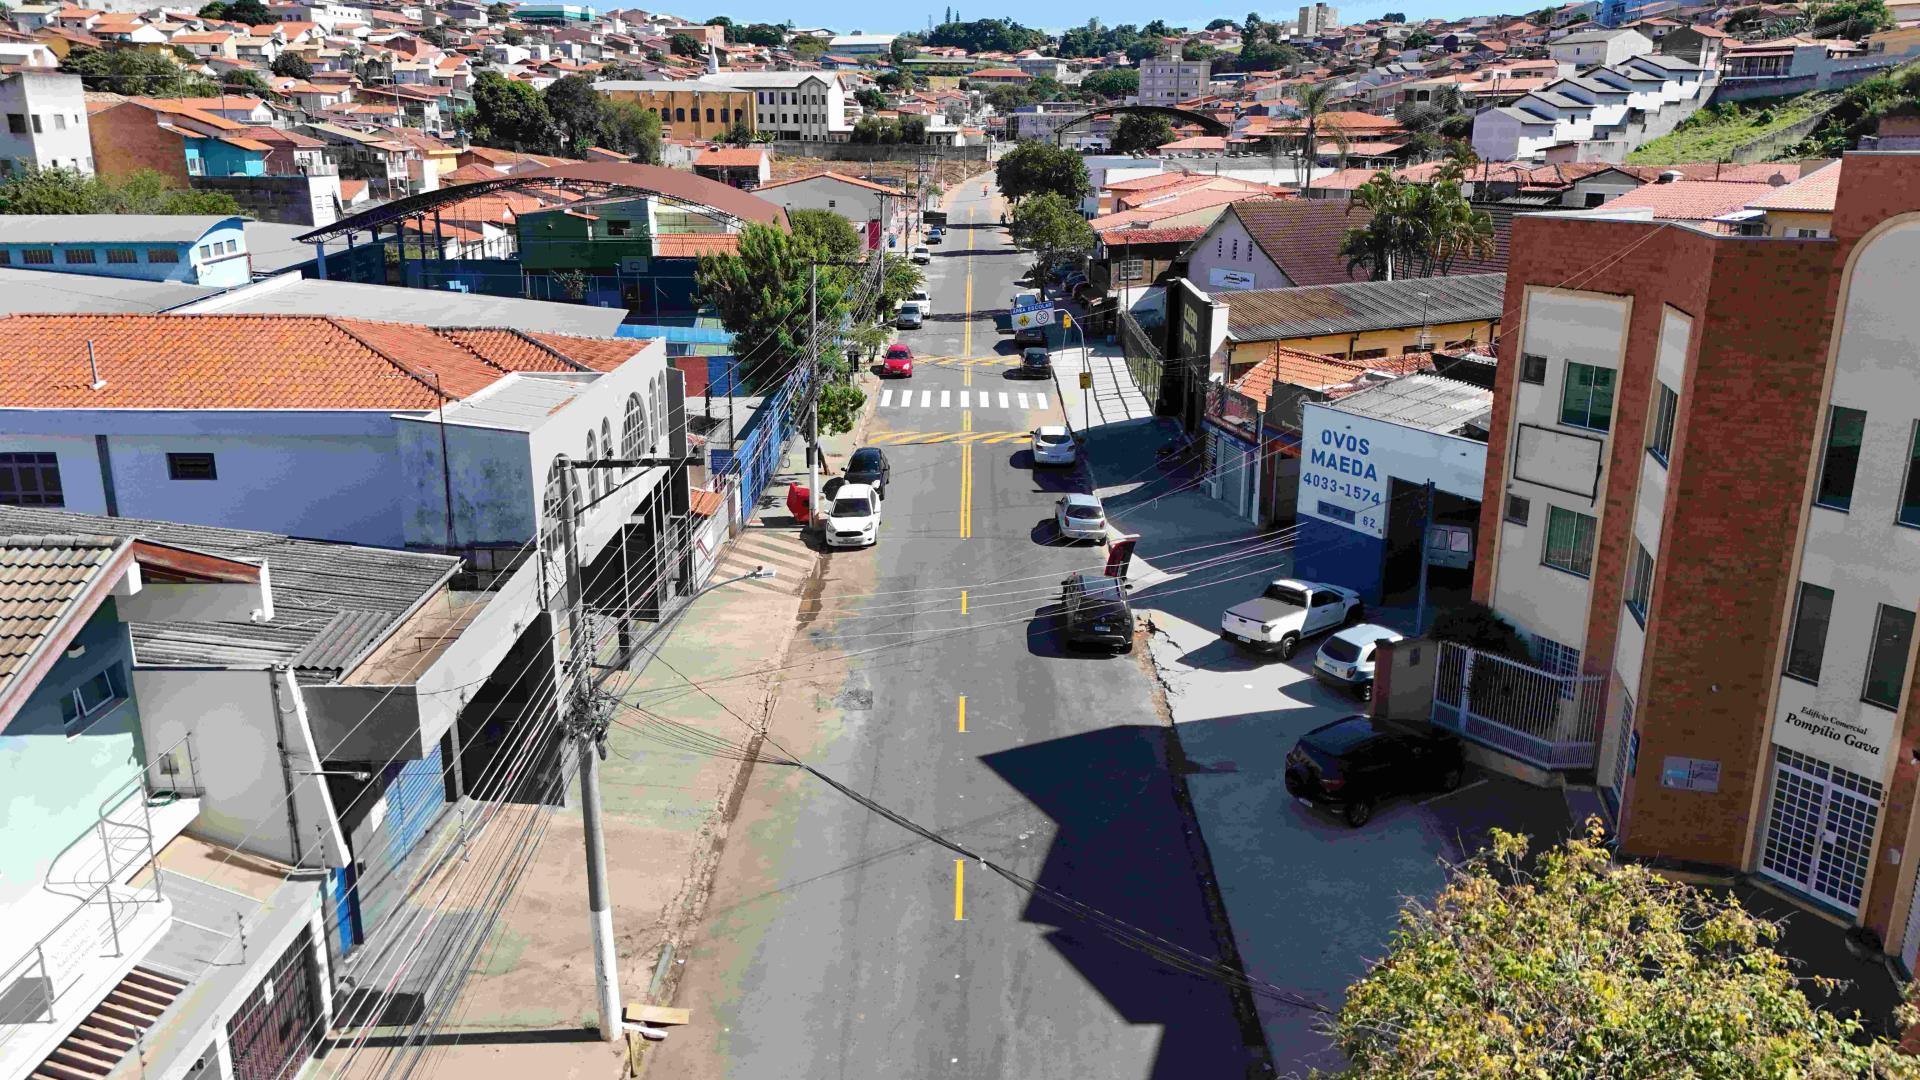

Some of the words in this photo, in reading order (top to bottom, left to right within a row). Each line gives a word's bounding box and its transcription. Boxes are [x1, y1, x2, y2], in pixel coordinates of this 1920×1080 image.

[1038, 312, 1047, 321] 30
[1321, 428, 1370, 456] OVOS
[1311, 448, 1377, 482] MAEDA
[1303, 472, 1380, 506] 4033-1574
[1362, 516, 1376, 529] 62
[1830, 716, 1868, 735] Comercial
[1844, 733, 1880, 755] Gava
